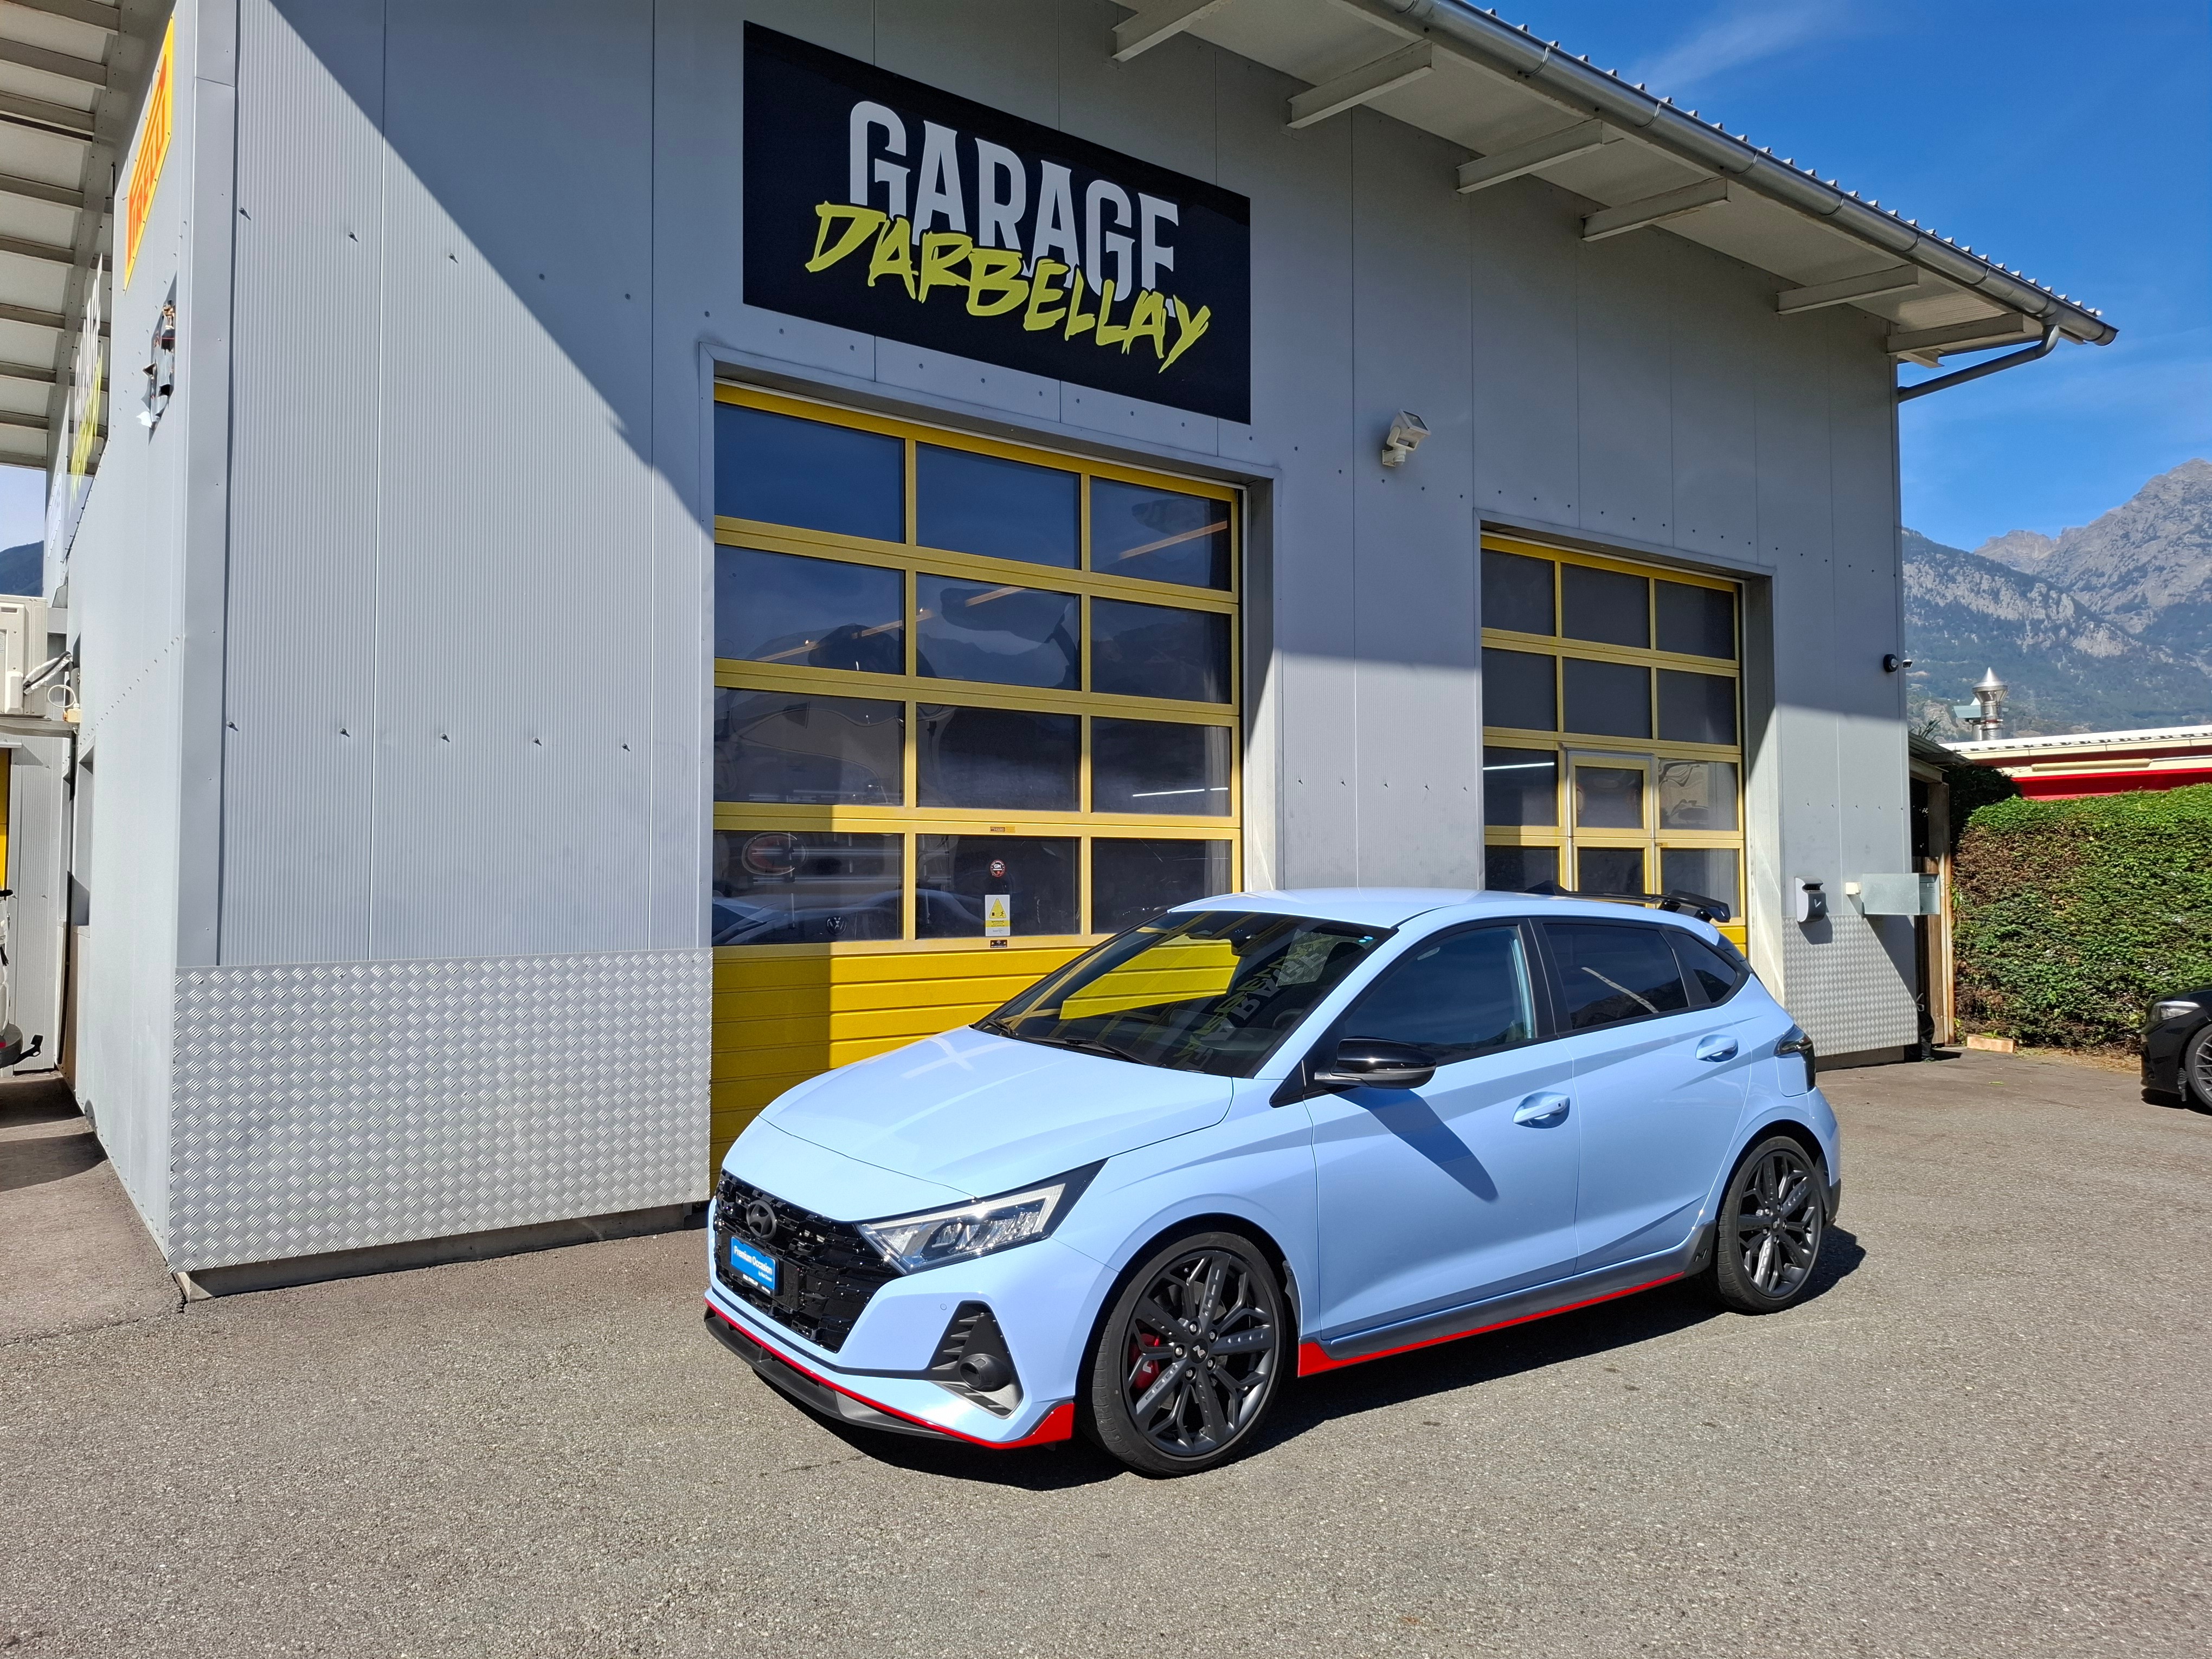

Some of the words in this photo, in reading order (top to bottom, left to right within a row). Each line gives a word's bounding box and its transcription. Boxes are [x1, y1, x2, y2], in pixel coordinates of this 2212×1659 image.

[127, 54, 167, 270] PIRELLI
[850, 100, 1179, 318] GARAGE
[805, 200, 1212, 374] DARBELLAY
[734, 1245, 752, 1264] Premium
[752, 1256, 772, 1275] Occasion
